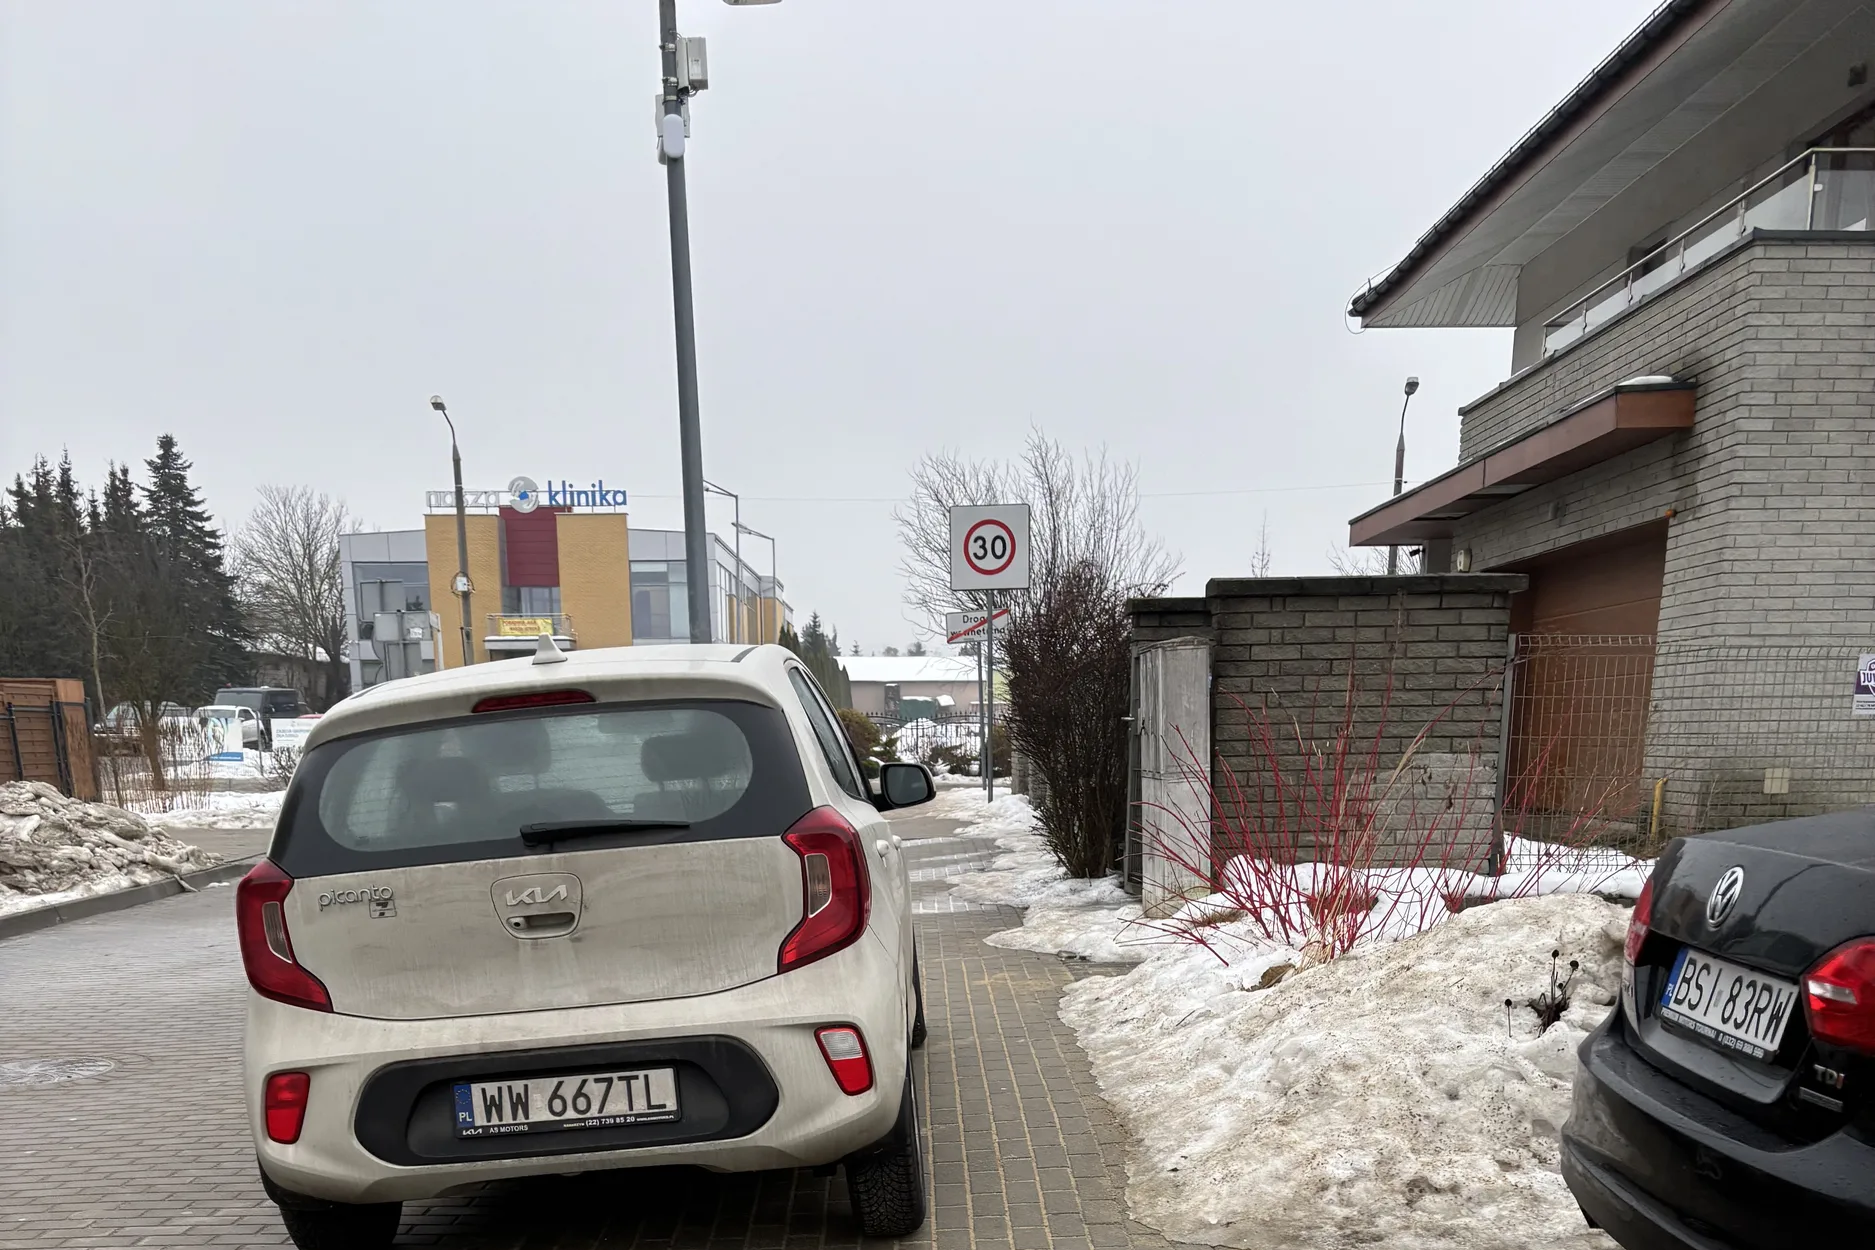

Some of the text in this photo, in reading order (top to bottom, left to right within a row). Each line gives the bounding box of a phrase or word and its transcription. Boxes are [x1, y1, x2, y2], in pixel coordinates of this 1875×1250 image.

[548, 480, 627, 506] klinika
[973, 535, 1007, 560] 30
[962, 614, 992, 626] Dro
[1862, 672, 1875, 684] JU
[318, 884, 394, 911] picanto
[506, 884, 568, 906] KIA
[1673, 957, 1722, 1016] BSI
[1721, 975, 1793, 1044] 83RW
[481, 1074, 667, 1124] WW 667TL
[459, 1112, 472, 1122] PL
[586, 1119, 600, 1127] (22)
[500, 1124, 529, 1133] MOTORS
